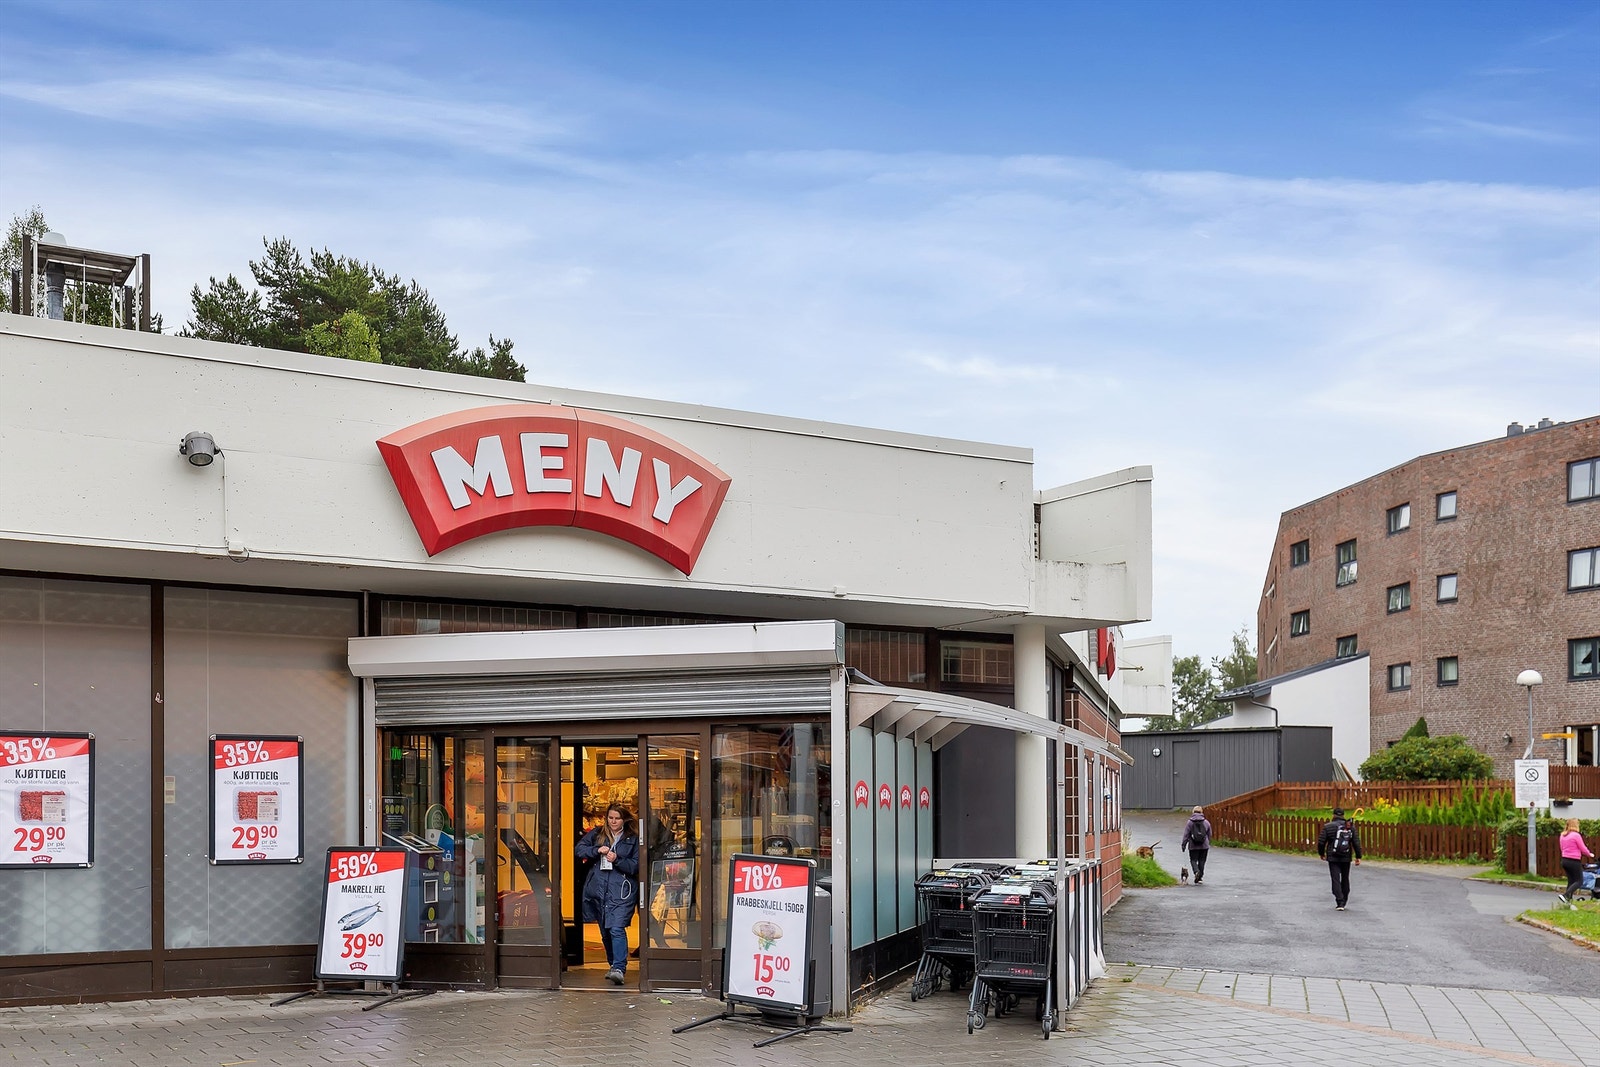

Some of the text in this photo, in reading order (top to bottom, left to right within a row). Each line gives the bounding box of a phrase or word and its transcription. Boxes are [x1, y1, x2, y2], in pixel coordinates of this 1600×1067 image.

[430, 431, 704, 524] MENY
[215, 740, 269, 767] -35%
[15, 769, 66, 780] KJØTTDEIG
[233, 770, 279, 780] KJØTTDEIG
[330, 852, 378, 880] -59%
[734, 863, 782, 891] -78%
[341, 885, 386, 894] MAKRELL HEL
[736, 896, 805, 914] KRABBESKJELL 150GR
